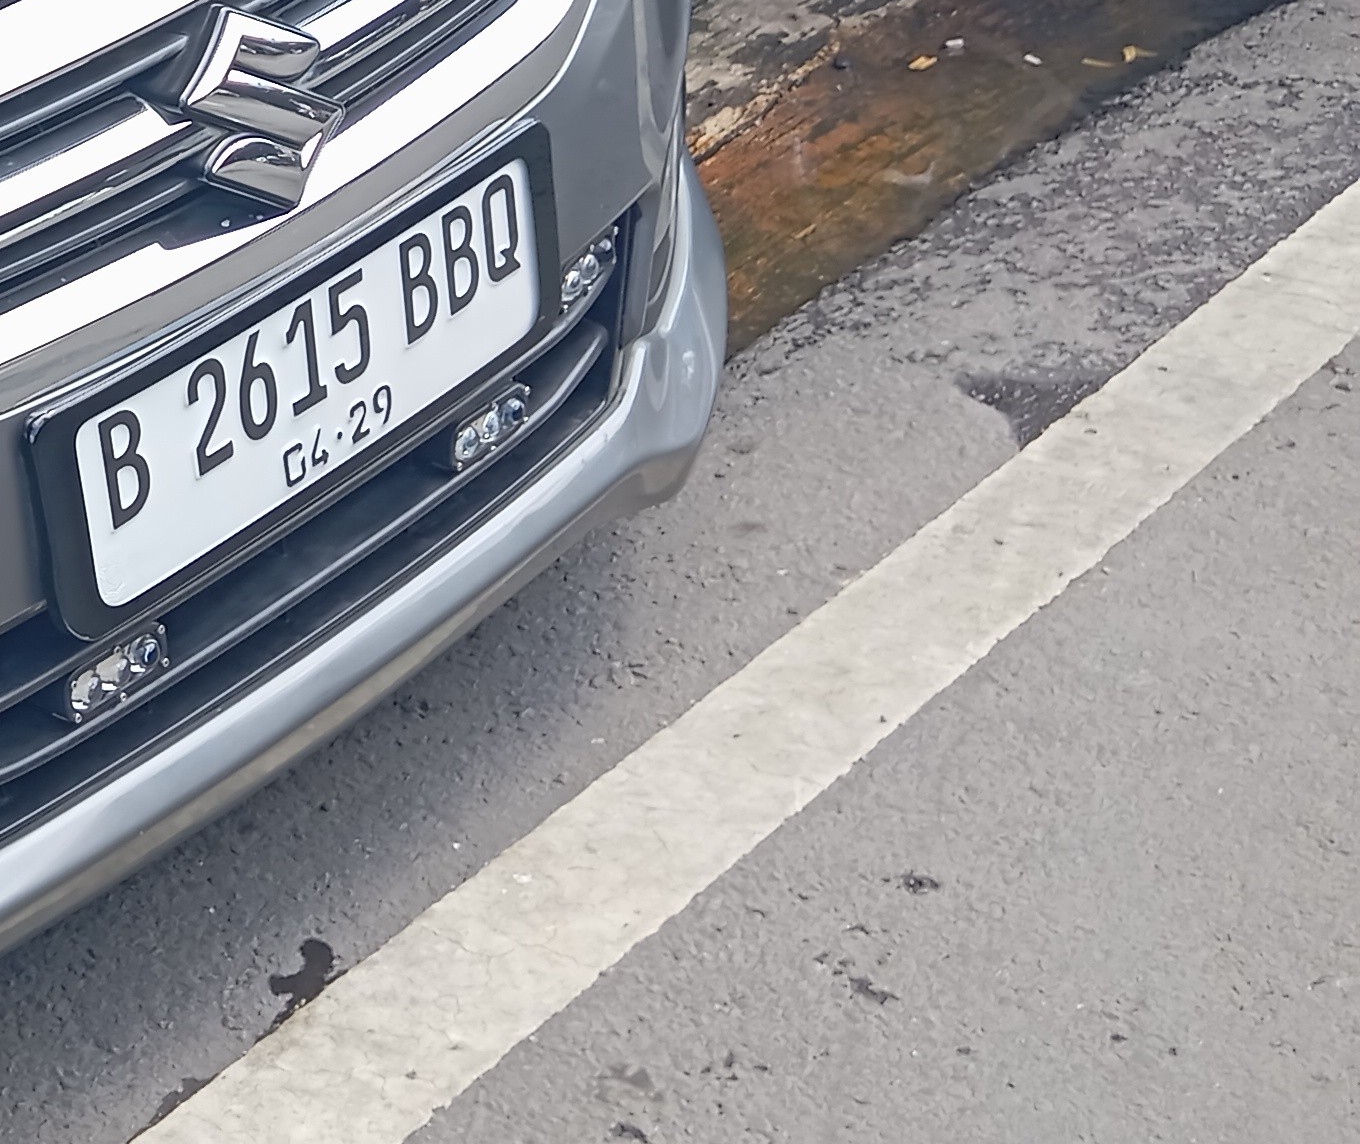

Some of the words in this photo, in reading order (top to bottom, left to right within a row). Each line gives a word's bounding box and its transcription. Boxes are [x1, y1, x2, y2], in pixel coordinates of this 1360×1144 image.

[98, 409, 151, 531] B
[185, 268, 372, 477] 2615
[399, 174, 521, 346] BBQ
